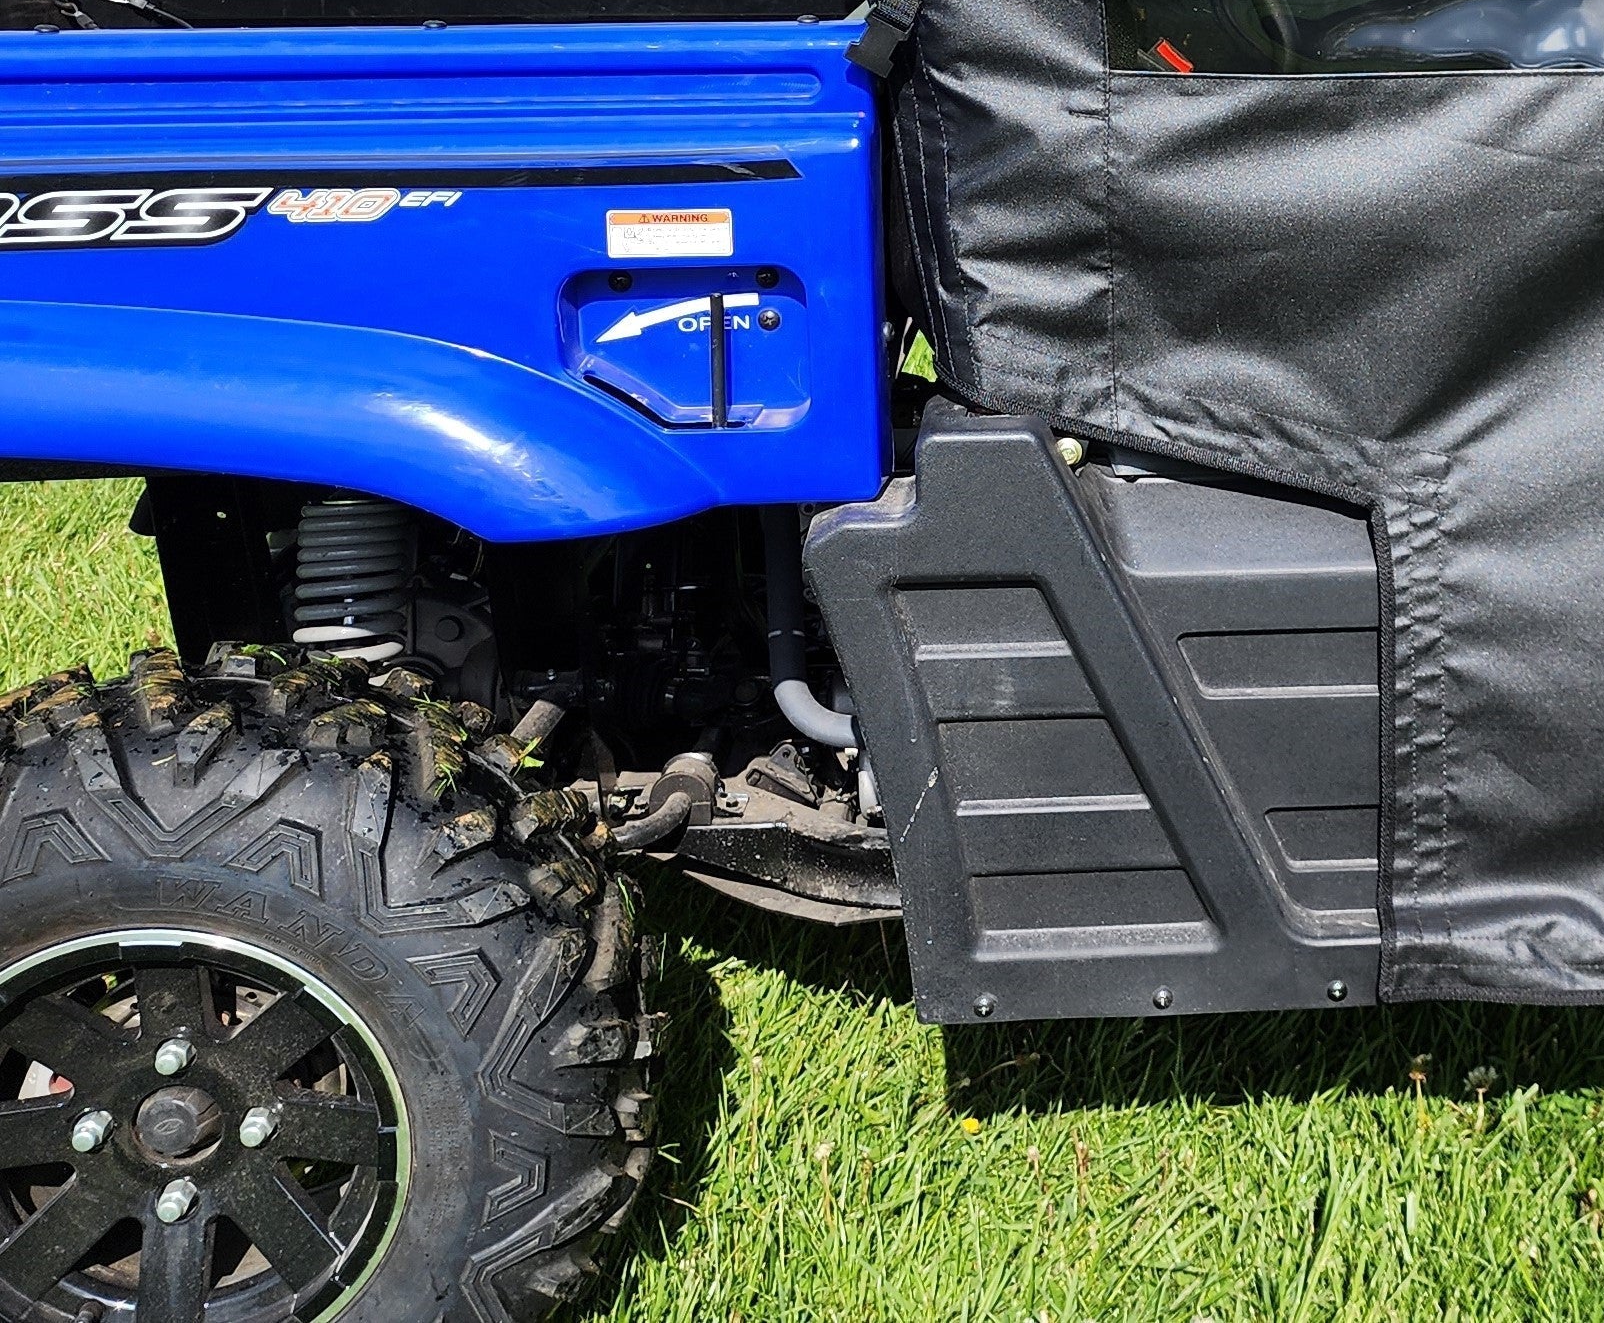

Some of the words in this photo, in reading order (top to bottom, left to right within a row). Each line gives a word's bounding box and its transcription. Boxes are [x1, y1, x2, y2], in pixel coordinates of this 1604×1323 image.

[0, 187, 274, 243] SS
[267, 188, 400, 223] 410
[399, 191, 463, 207] EFI
[652, 213, 708, 223] WARNING
[157, 877, 426, 1028] WANDA
